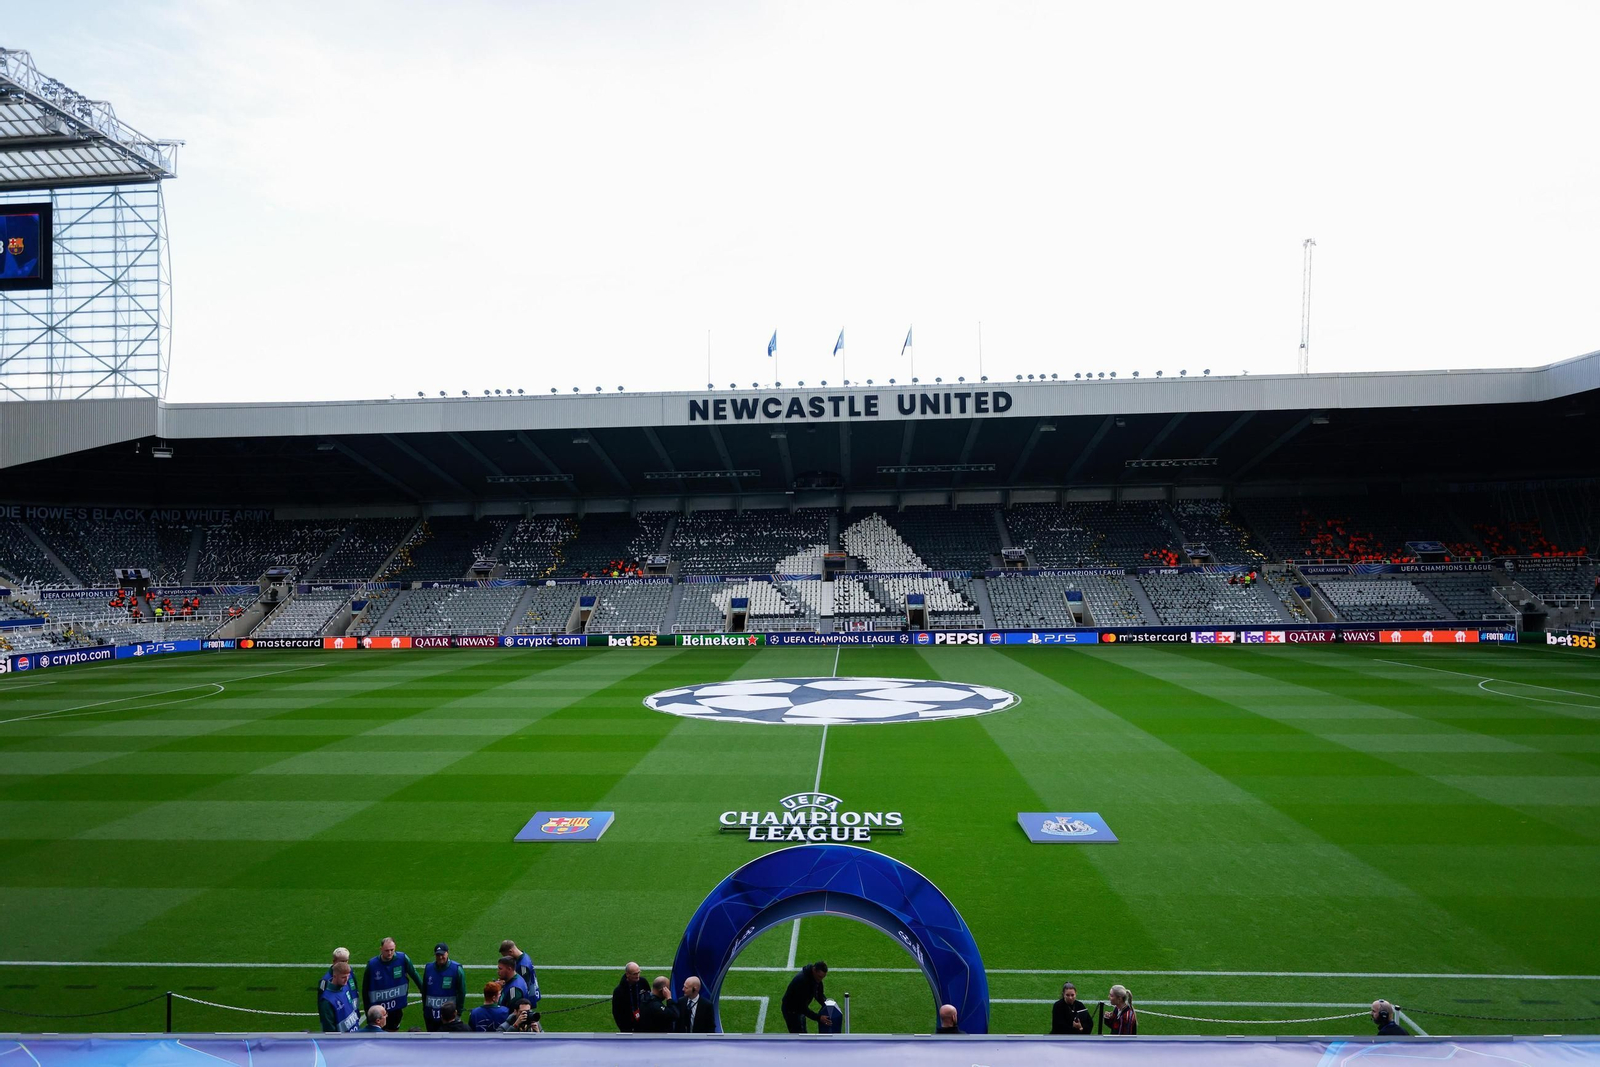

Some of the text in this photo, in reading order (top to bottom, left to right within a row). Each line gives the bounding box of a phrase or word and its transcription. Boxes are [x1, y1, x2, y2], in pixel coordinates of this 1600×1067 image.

[689, 391, 1013, 421] NEWCASTLE UNITED
[26, 506, 87, 520] HOWE'S
[93, 509, 147, 520] BLACK
[150, 510, 181, 520] AND
[185, 510, 230, 520] WHITE
[234, 510, 272, 521] ARMY
[256, 638, 321, 647] mastercard
[517, 635, 581, 647] cryptocom
[608, 635, 657, 646] bet365
[682, 635, 746, 646] Heineken
[783, 635, 895, 644] UEFA CHAMPIONS LEAGUE
[935, 633, 984, 644] PEPSI
[1044, 634, 1077, 643] PS5
[1195, 632, 1231, 643] FedEx
[1244, 631, 1280, 643] FedEx
[1289, 632, 1376, 643] QATAR ARWAYS
[1546, 632, 1596, 649] bet365
[146, 643, 176, 652] PS5
[415, 638, 449, 648] QATAR
[53, 650, 110, 665] crypto.com
[782, 794, 838, 810] UEFA
[719, 811, 903, 827] CHAMPIONS
[748, 826, 871, 842] LEAGUE
[376, 987, 400, 1000] PITCH
